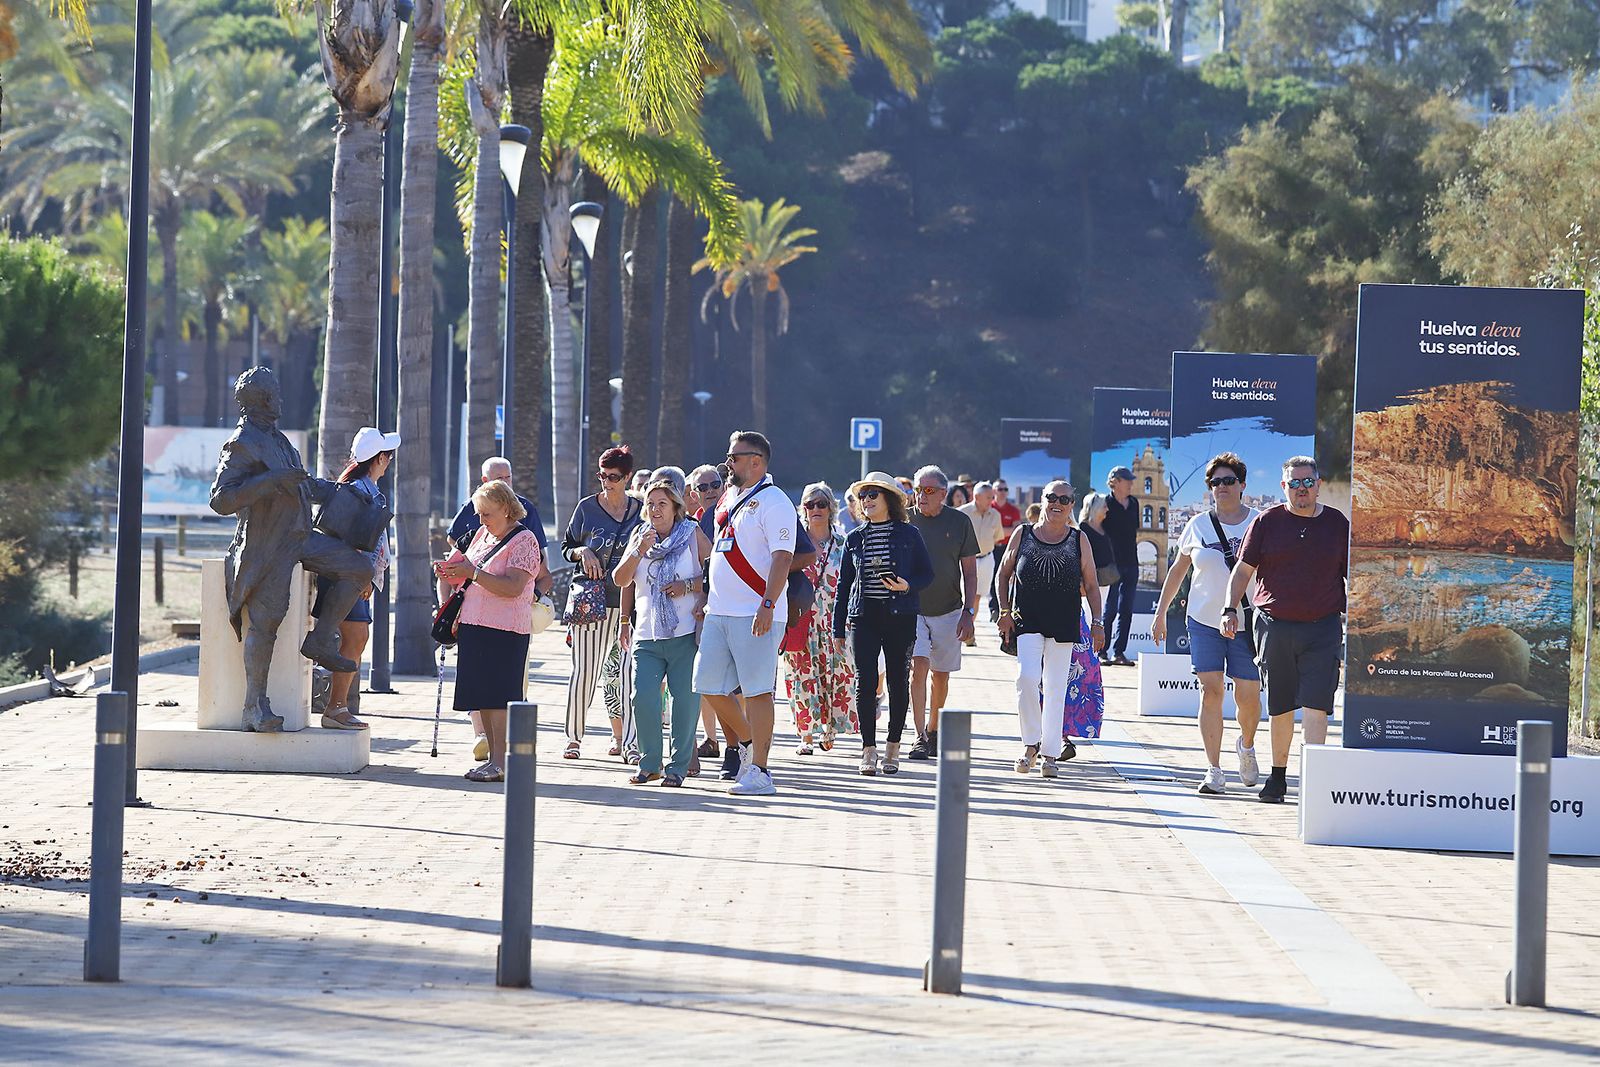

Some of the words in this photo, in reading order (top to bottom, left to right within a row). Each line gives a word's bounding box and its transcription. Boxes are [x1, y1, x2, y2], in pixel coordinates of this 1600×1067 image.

[1420, 320, 1477, 336] Huelva
[1481, 321, 1521, 338] eleva
[1419, 340, 1445, 354] tus
[1447, 340, 1521, 356] sentidos.
[1212, 377, 1249, 388] Huelva
[1251, 378, 1277, 389] eleva
[1211, 390, 1228, 400] tus
[1230, 390, 1277, 401] sentidos.
[1122, 408, 1150, 417] Huelva
[1121, 417, 1135, 425] tus
[857, 423, 875, 446] P
[779, 528, 790, 541] 2
[1377, 667, 1398, 675] Gruta
[1399, 668, 1409, 676] de
[1410, 668, 1421, 676] las
[1422, 669, 1458, 678] Maravillas
[1459, 670, 1494, 679] (Aracena)
